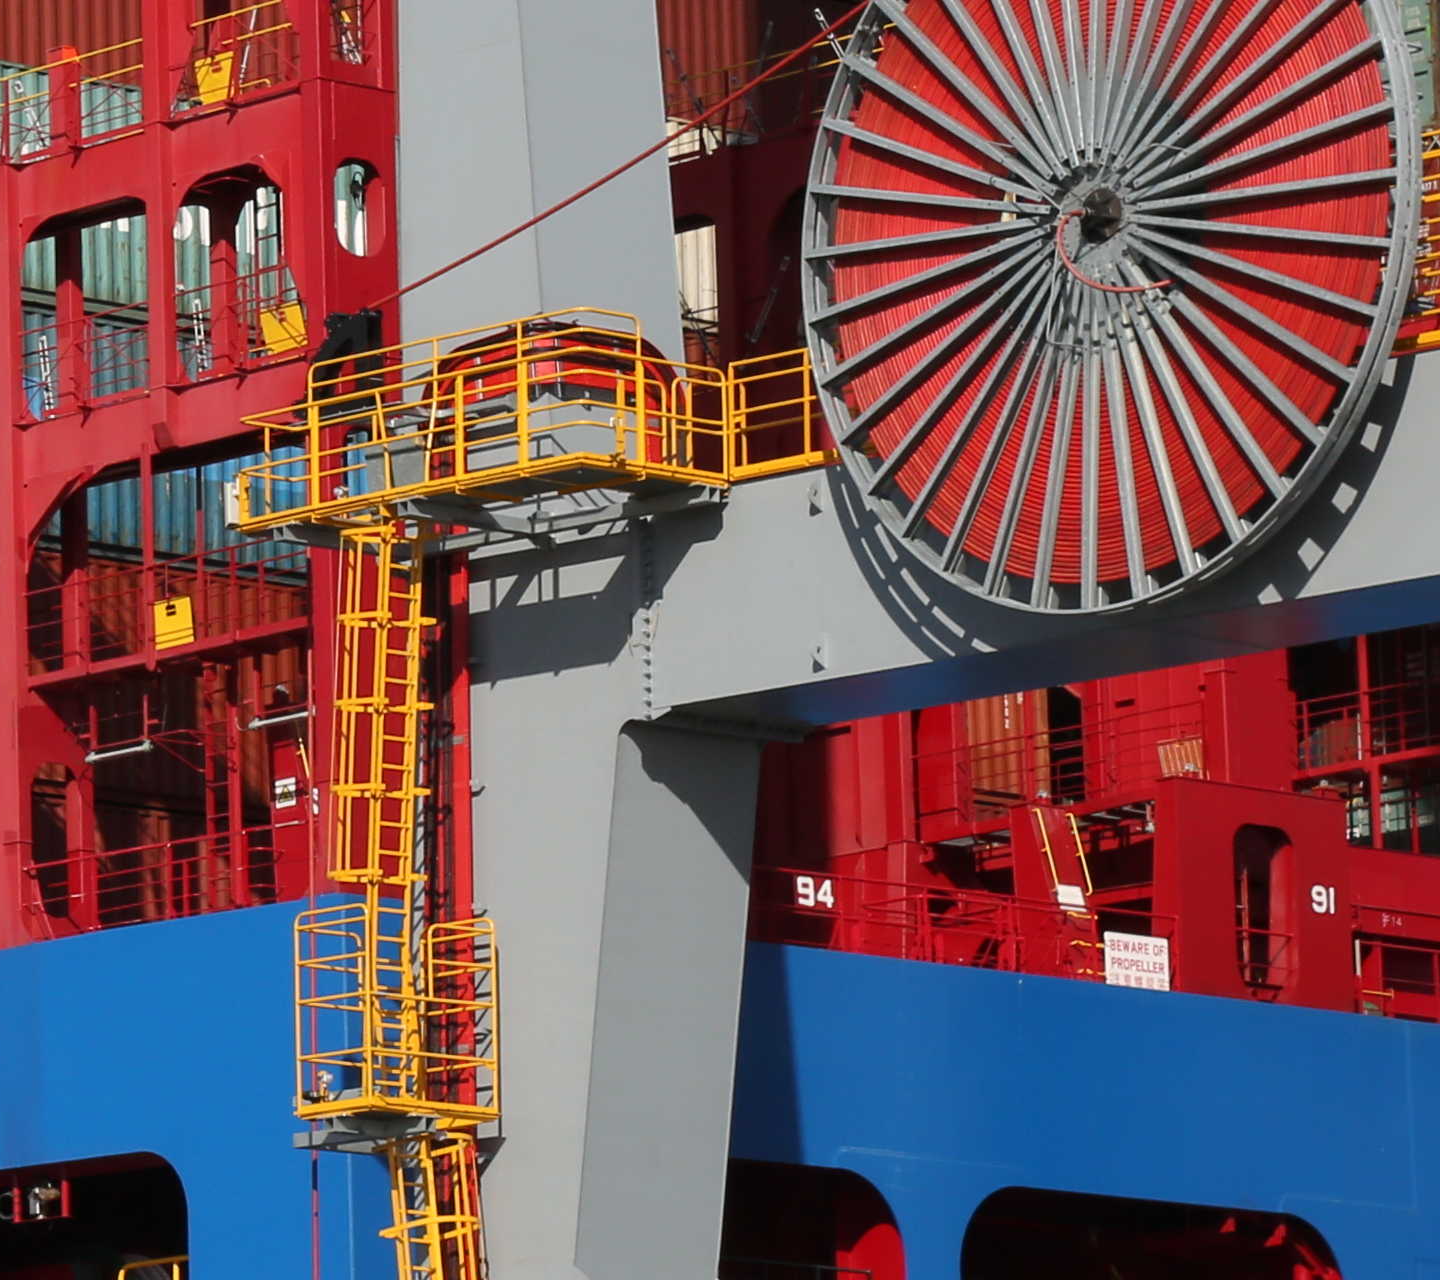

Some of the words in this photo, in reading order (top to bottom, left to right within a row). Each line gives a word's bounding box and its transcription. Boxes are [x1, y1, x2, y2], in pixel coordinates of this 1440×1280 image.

[796, 875, 834, 909] 94
[1311, 885, 1335, 914] 91
[1109, 939, 1150, 956] BEWARE
[1153, 944, 1166, 957] OF
[1111, 957, 1165, 974] PROPELLER
